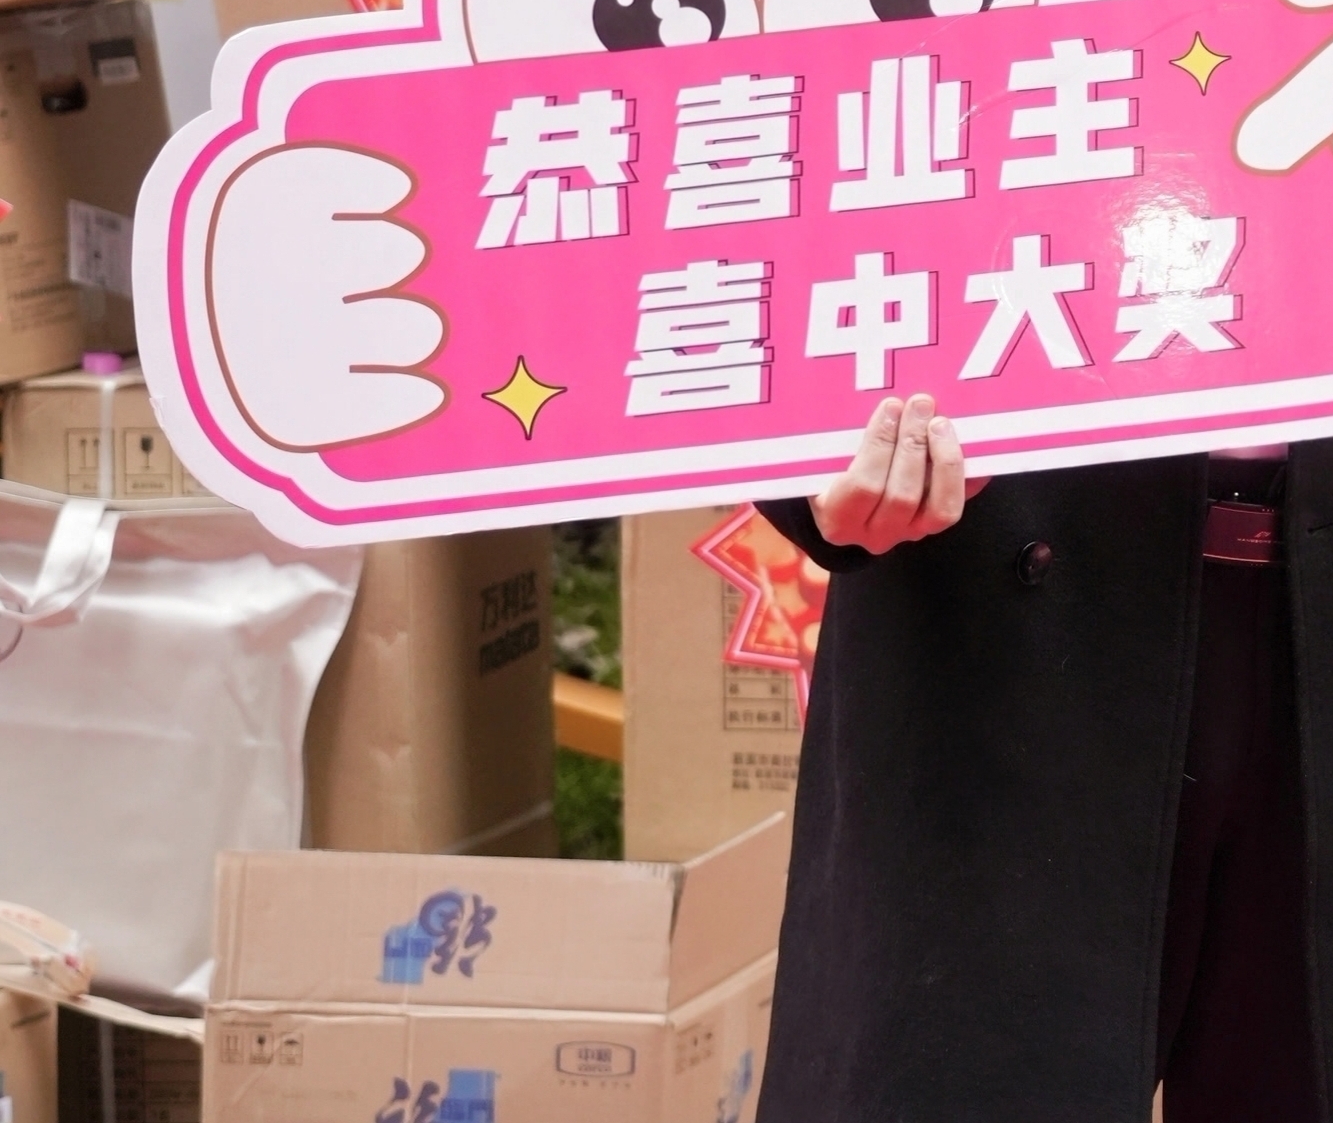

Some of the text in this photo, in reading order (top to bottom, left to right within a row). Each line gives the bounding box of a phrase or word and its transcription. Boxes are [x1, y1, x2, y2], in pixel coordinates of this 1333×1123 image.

[475, 38, 1144, 250] 恭喜业主
[624, 216, 1247, 418] 喜中大奖
